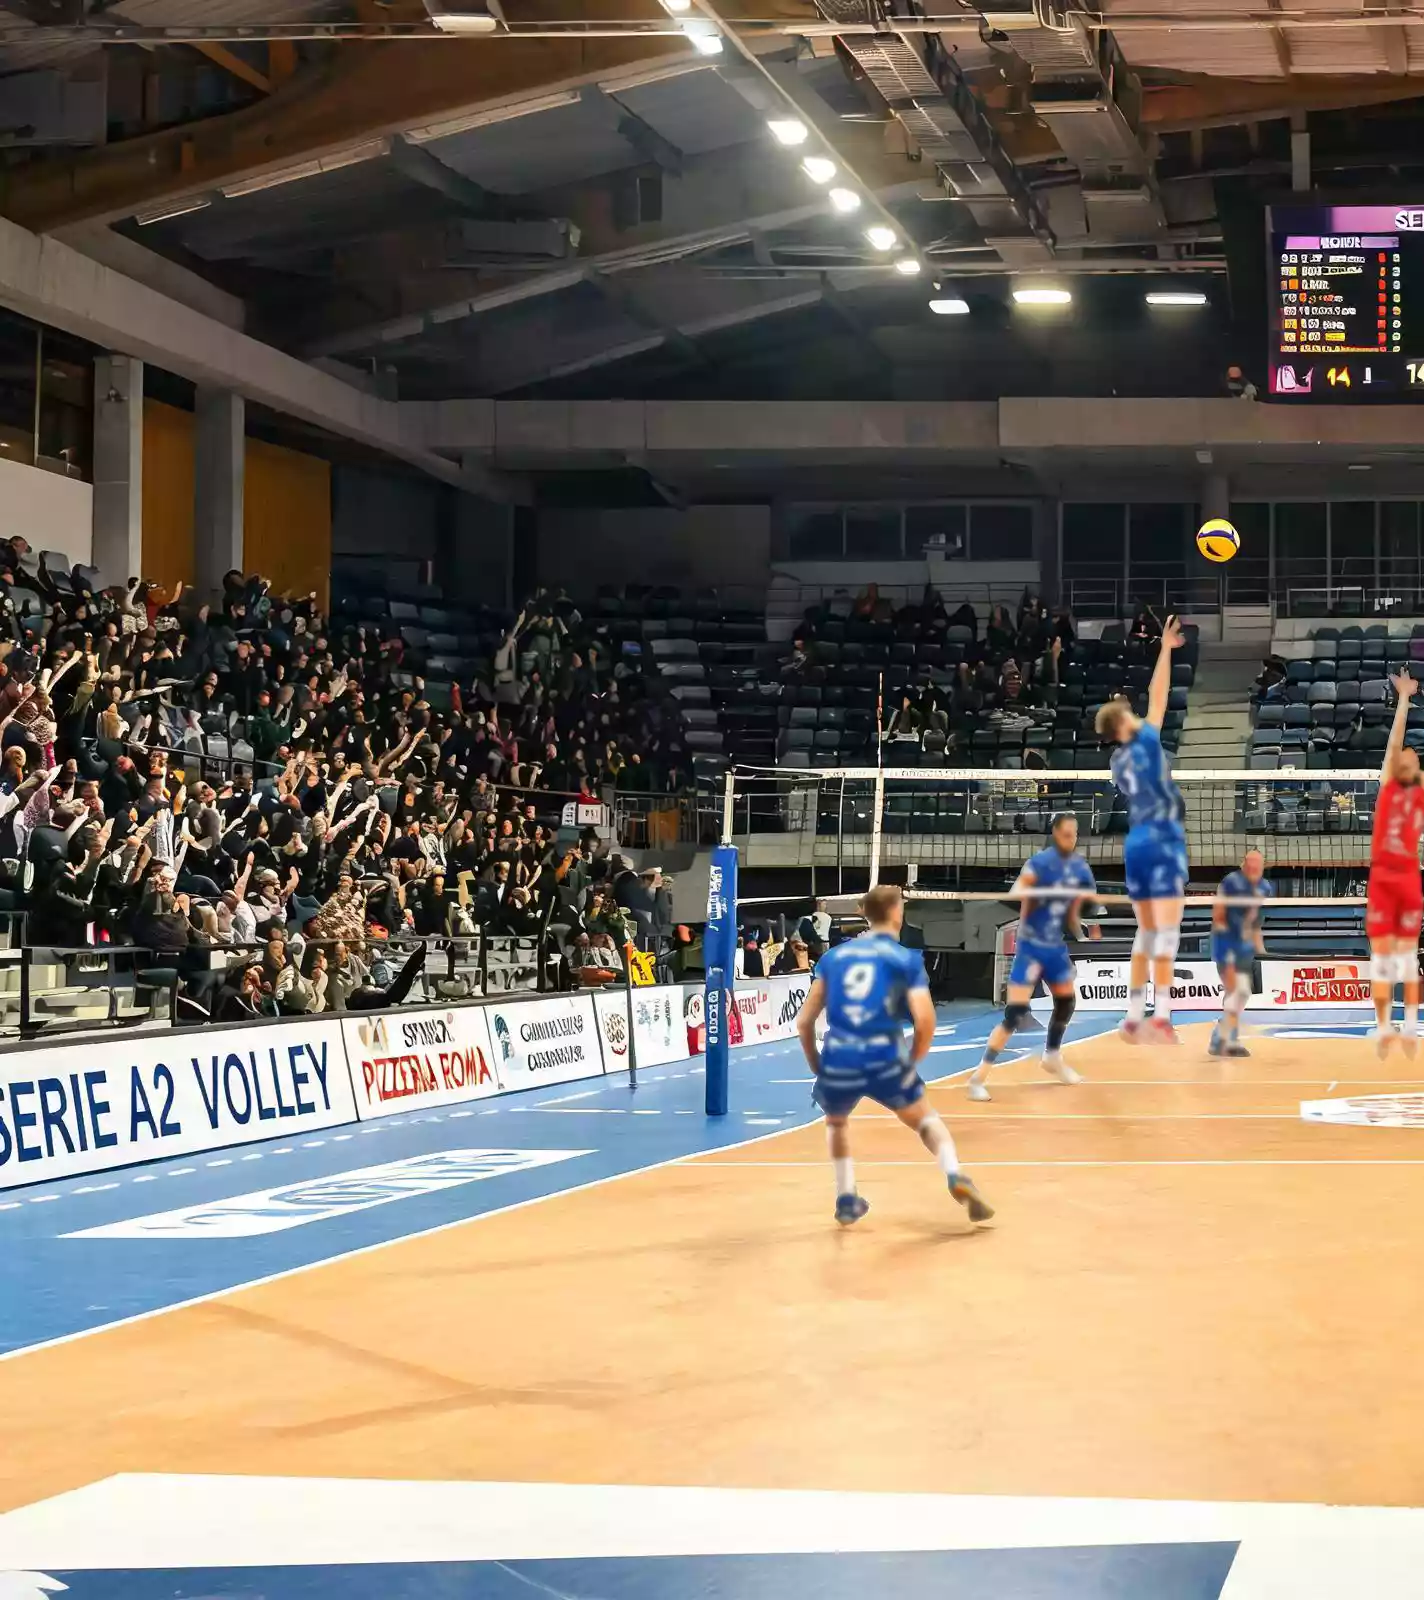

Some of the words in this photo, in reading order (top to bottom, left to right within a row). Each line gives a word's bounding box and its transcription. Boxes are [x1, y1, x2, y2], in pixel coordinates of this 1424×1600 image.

[843, 962, 876, 1000] 9
[130, 1062, 182, 1142] A2
[191, 1041, 331, 1130] VOLLEY
